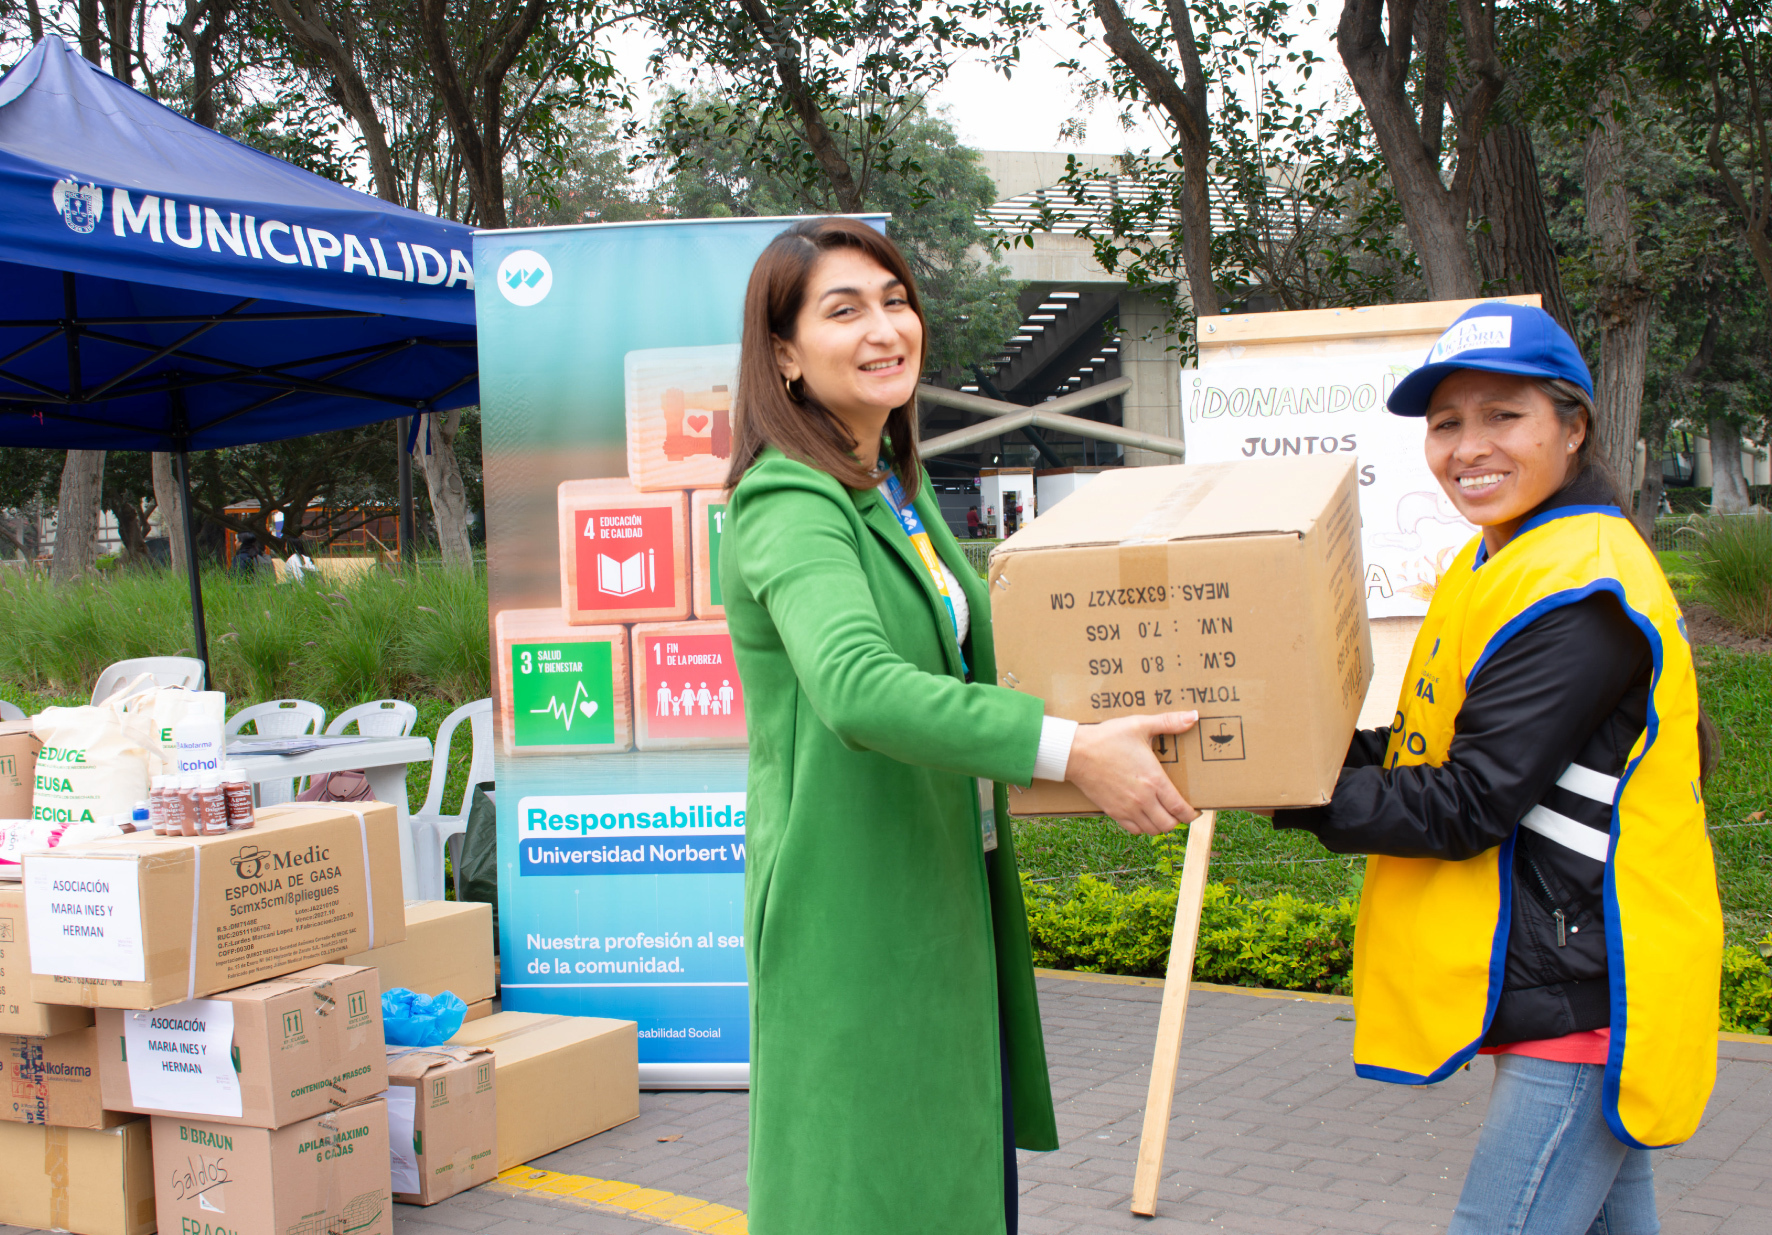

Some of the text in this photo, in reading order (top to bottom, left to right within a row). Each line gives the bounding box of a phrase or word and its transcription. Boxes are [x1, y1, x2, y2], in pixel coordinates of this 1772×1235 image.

[112, 188, 474, 290] MUNICIPALIDA
[1241, 434, 1357, 457] JUNTOS
[584, 518, 595, 540] 4
[600, 514, 642, 527] EDUCACIÓN
[600, 528, 643, 539] DE CALIDAD
[1050, 592, 1075, 610] CM
[1086, 624, 1120, 641] KGS
[1138, 621, 1162, 638] 7.0
[1197, 617, 1233, 634] N.W.
[537, 650, 561, 660] SALUD
[653, 642, 661, 665] 1
[666, 643, 679, 654] FIN
[521, 651, 532, 674] 3
[538, 661, 583, 673] Y BIENESTAR
[667, 654, 722, 666] DE LA POBREZA
[1089, 658, 1123, 675] KGS
[1141, 656, 1164, 673] 8.0
[1200, 651, 1236, 669] G.W.
[1090, 686, 1240, 709] TOTAL: 24 BOXES
[39, 747, 87, 763] EDUCE
[527, 804, 746, 836] Responsabilida
[273, 845, 330, 870] Medic
[528, 843, 746, 864] Universidad Norbert W
[53, 879, 109, 893] ASOCIACIÓN
[225, 866, 342, 900] ESPONJA DE GASA
[230, 885, 339, 916] 5cmx5cm/8pliegues
[52, 903, 113, 916] MARIA INES Y
[63, 925, 104, 937] HERMAN
[527, 932, 745, 952] Nuestra profesión al ser
[527, 957, 684, 974] de la comunidad.
[10, 1005, 19, 1014] CM
[151, 1018, 206, 1032] ASOCIACIÓN
[689, 1027, 721, 1038] Social
[149, 1040, 207, 1055] MARIA INES Y
[40, 1062, 91, 1077] Alkofarma
[162, 1061, 202, 1074] HERMAN
[333, 1075, 341, 1083] 24
[342, 1065, 372, 1080] FRASCOS
[298, 1126, 370, 1154] APILAR MAXIMO
[316, 1144, 354, 1162] 6 CAJAS
[172, 1154, 229, 1200] Saldos
